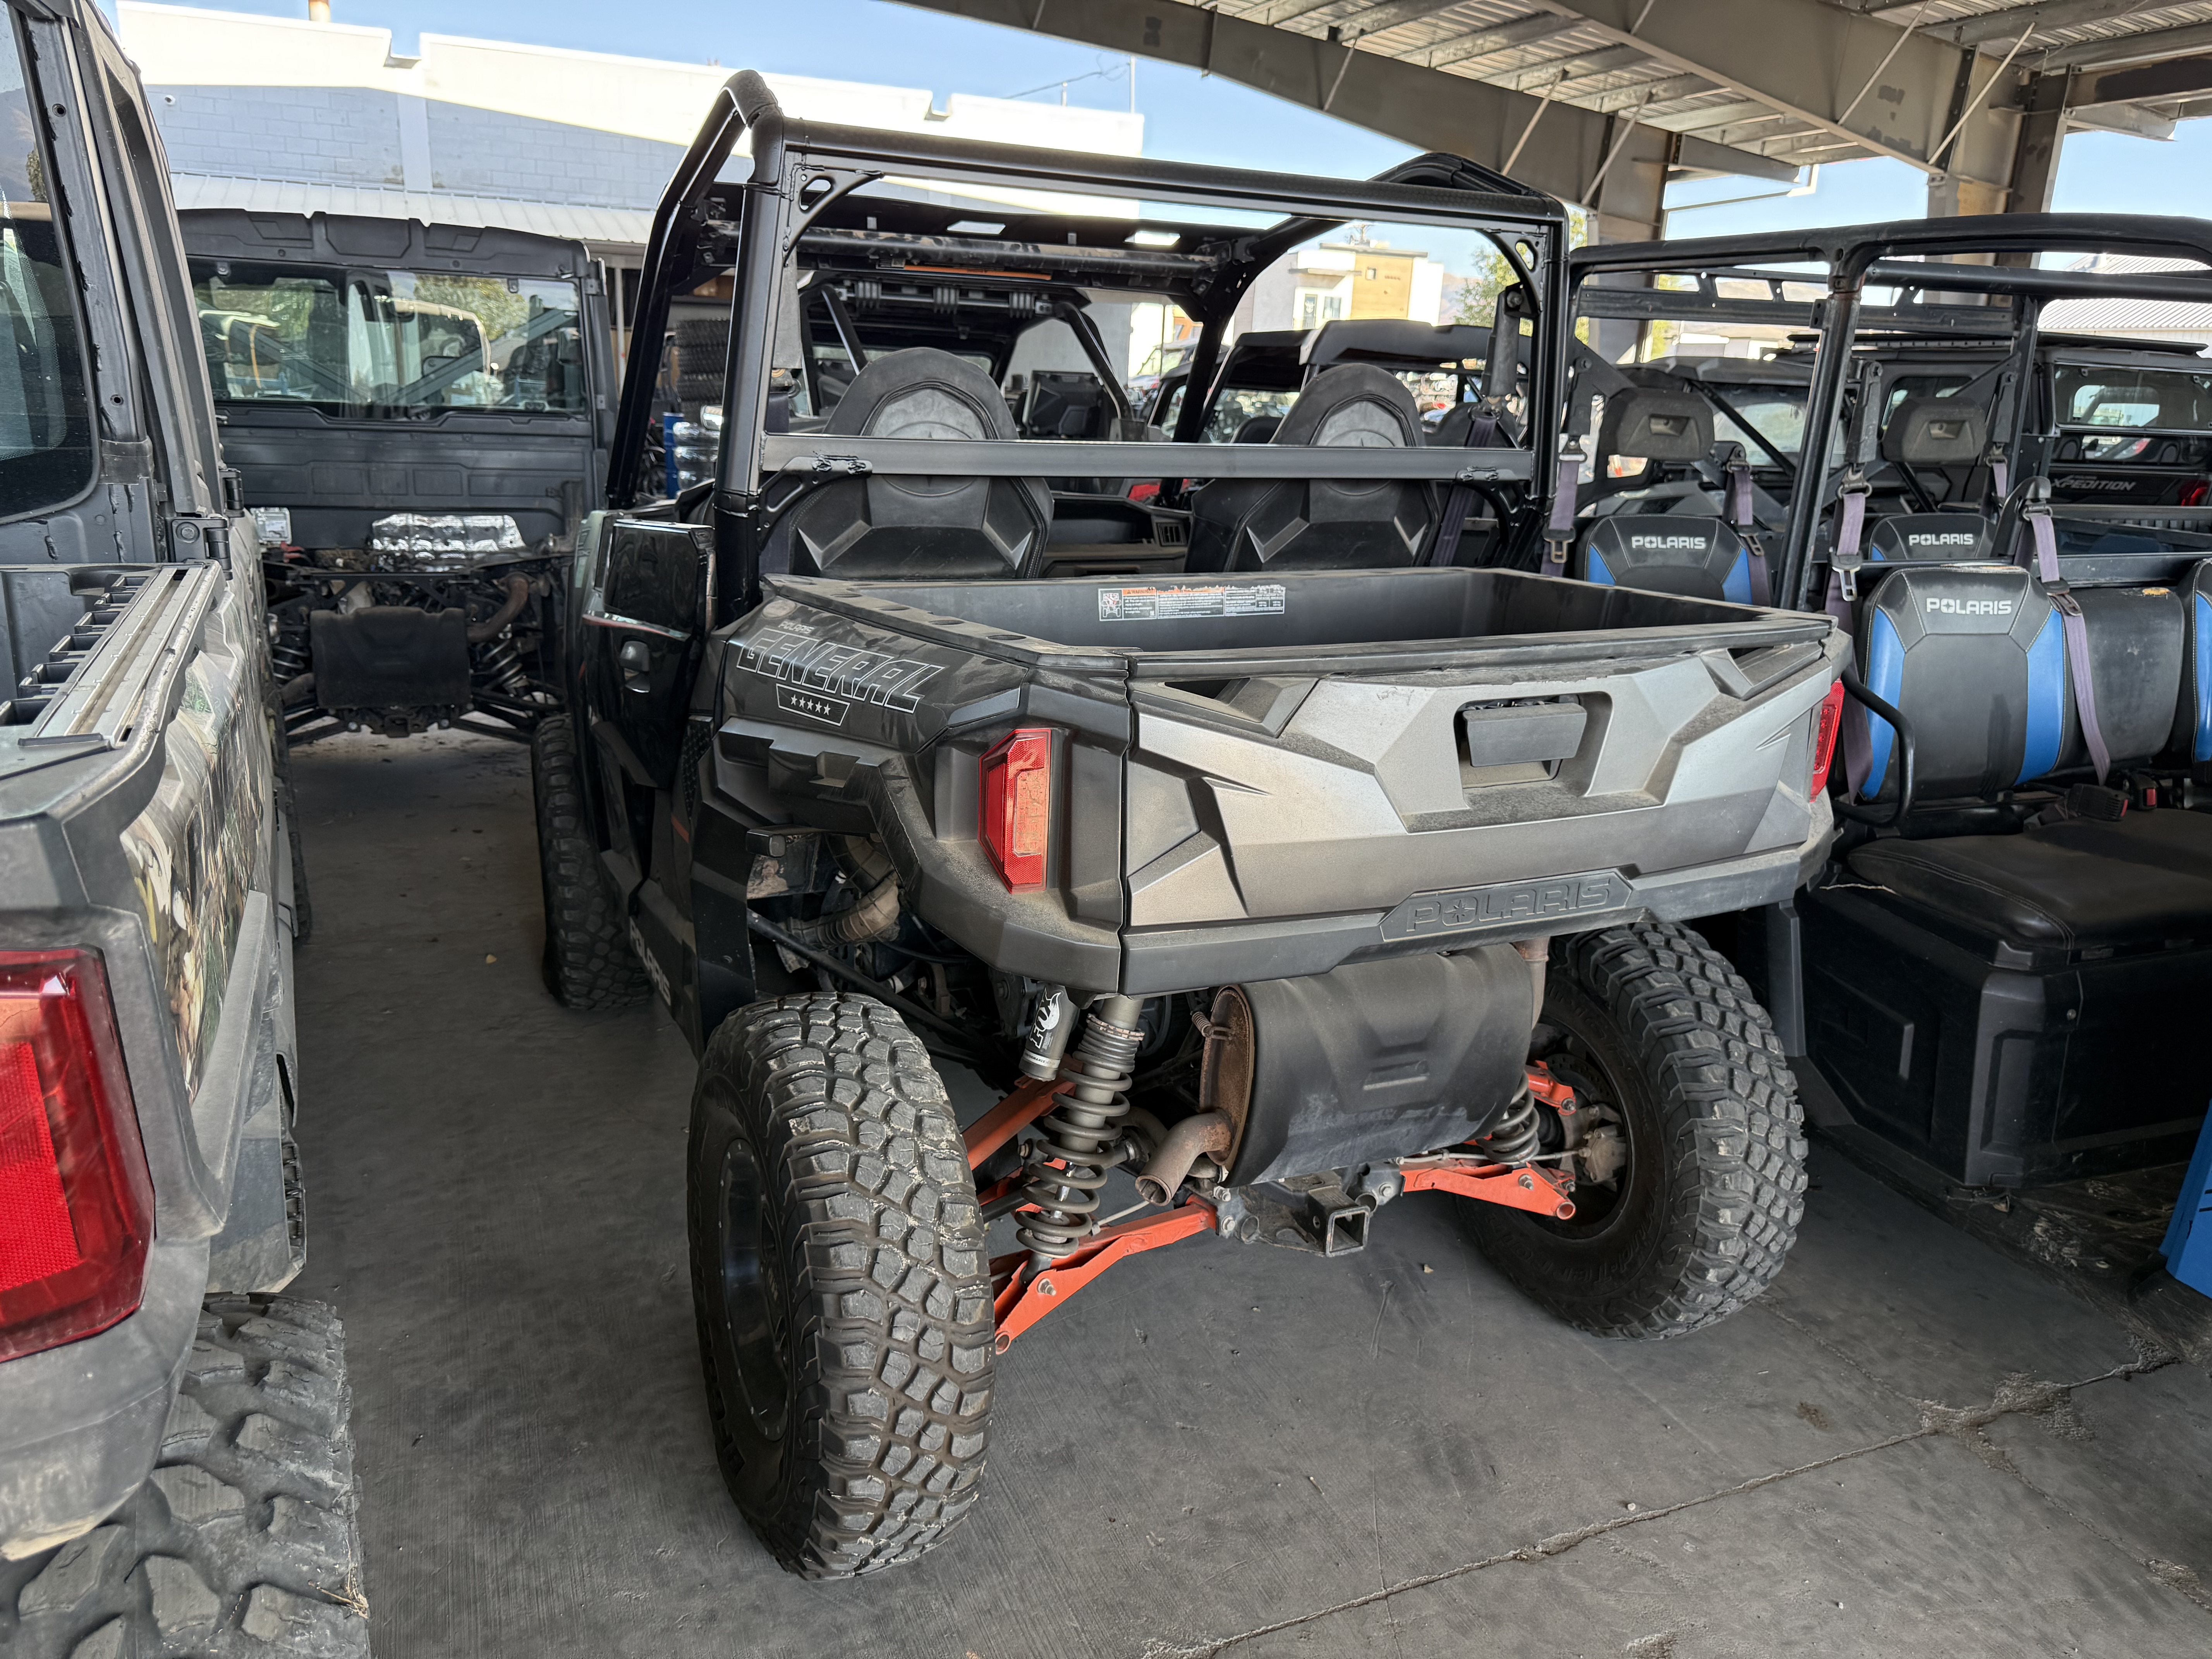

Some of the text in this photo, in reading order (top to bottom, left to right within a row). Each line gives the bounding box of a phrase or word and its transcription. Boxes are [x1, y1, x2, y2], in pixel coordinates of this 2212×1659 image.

[1632, 536, 1706, 549] POLARIS
[1909, 533, 1973, 546] POLARIS
[1926, 598, 2011, 615] POLARIS
[778, 620, 816, 634] POLARIS
[736, 627, 946, 714] GENERAL
[1406, 877, 1611, 933] POLARIS
[630, 916, 672, 1006] POLARIS
[1029, 986, 1056, 1049] FOX
